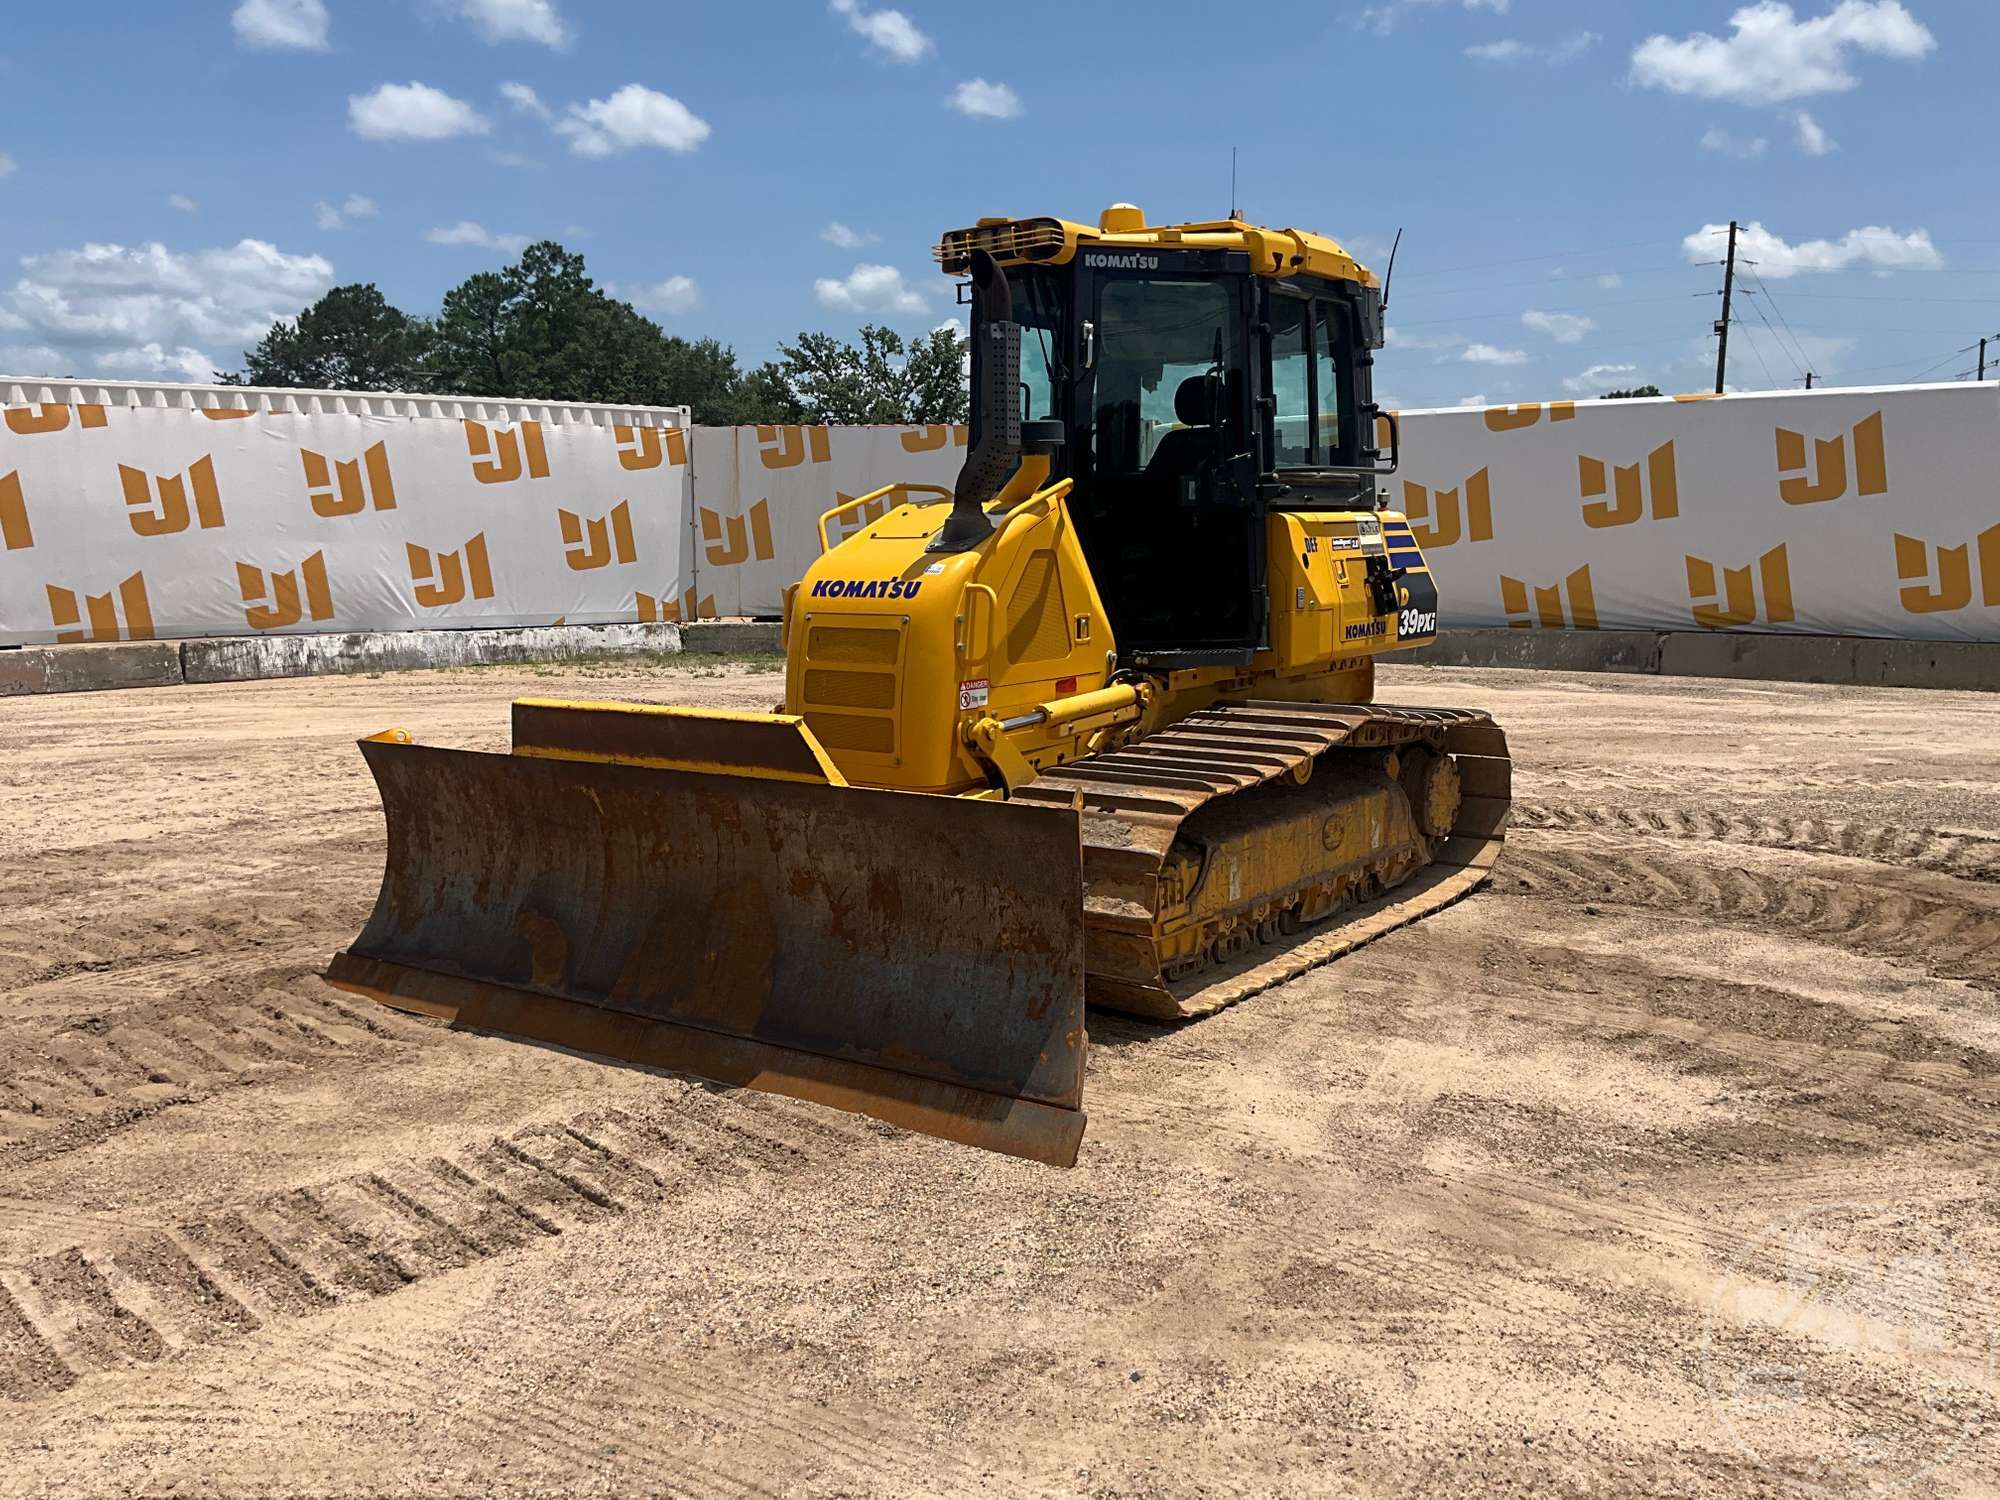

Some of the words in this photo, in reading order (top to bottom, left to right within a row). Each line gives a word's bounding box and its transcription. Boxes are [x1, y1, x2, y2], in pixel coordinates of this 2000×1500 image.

[1085, 253, 1159, 270] KOMATSU
[1304, 536, 1318, 553] DEF
[810, 576, 923, 600] KOMATSU
[1345, 619, 1387, 640] KOMATSU
[1399, 608, 1437, 636] 39PXi
[965, 680, 988, 690] DANGER
